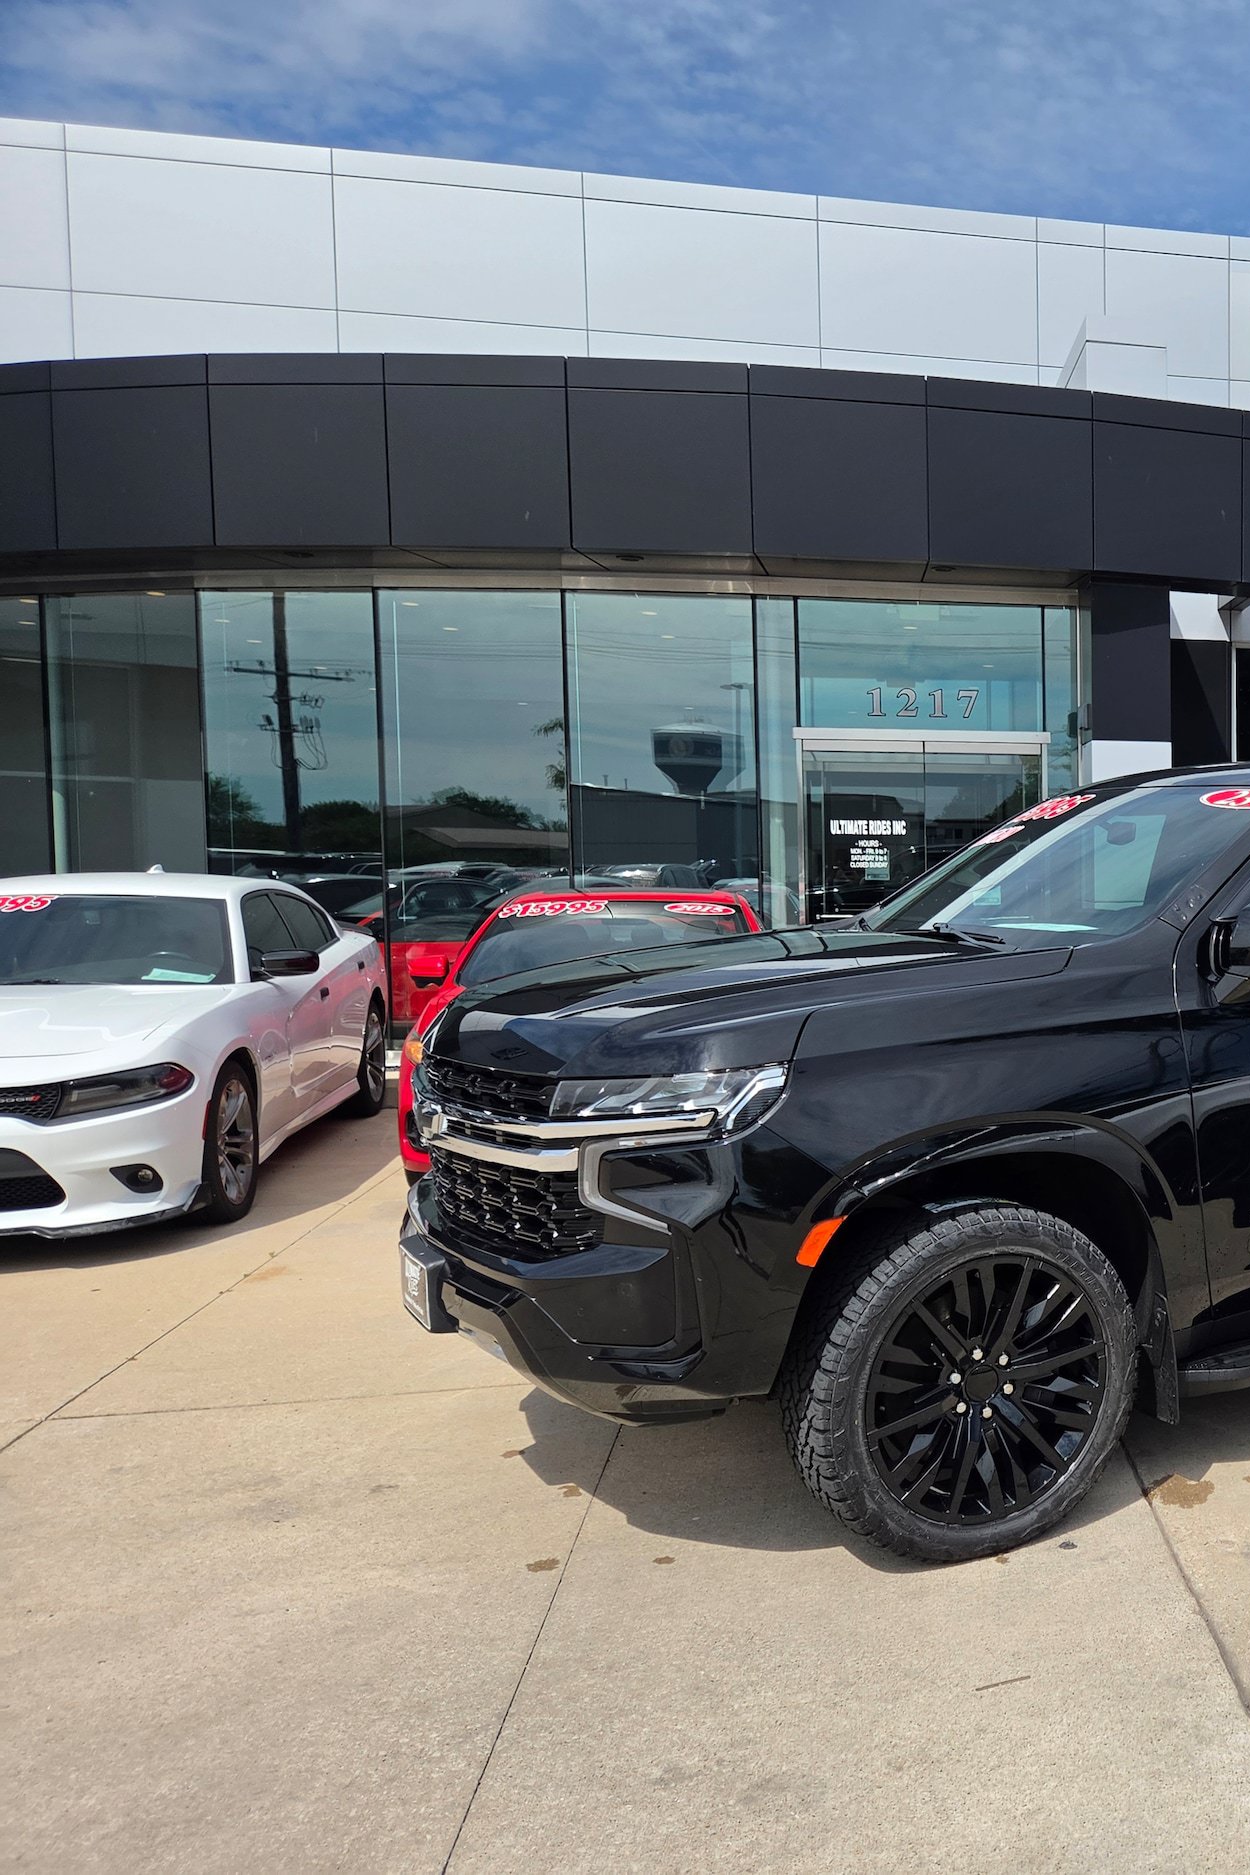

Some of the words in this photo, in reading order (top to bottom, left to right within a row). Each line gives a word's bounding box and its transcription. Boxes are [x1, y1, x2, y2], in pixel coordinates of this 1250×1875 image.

[866, 687, 979, 718] 1217
[830, 819, 868, 835] ULTIMATE
[869, 819, 892, 836] RIDES
[892, 819, 907, 836] INC
[858, 839, 880, 848] HOURS
[499, 900, 609, 918] $15995
